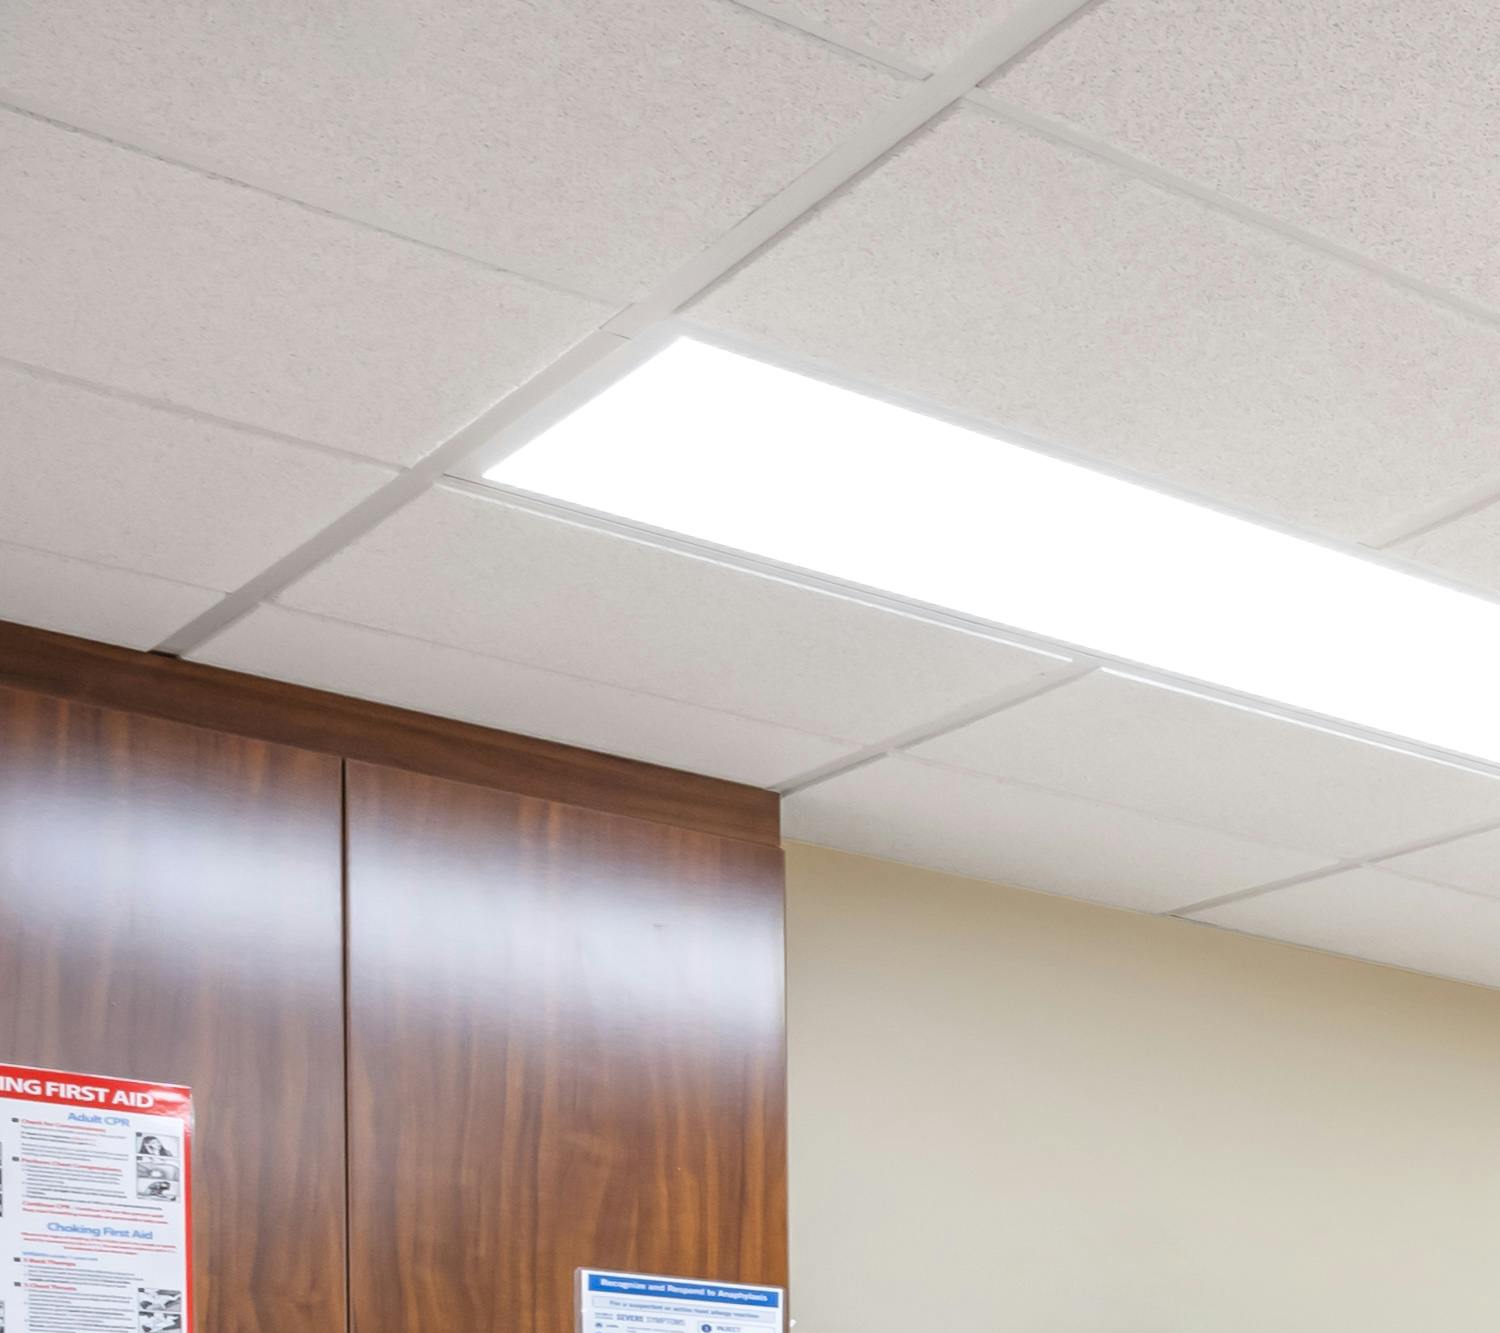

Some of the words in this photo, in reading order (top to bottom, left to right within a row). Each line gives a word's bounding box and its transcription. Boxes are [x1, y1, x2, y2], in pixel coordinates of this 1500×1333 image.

[45, 1081, 110, 1104] FIRST
[112, 1090, 155, 1108] AID
[68, 1112, 104, 1125] Adult
[104, 1116, 130, 1127] CPR
[47, 1222, 101, 1238] Choking
[103, 1227, 130, 1239] First
[132, 1228, 153, 1240] Aid
[599, 1278, 647, 1291] Recognize
[647, 1282, 666, 1293] and
[667, 1285, 706, 1297] Respond
[706, 1288, 716, 1296] to
